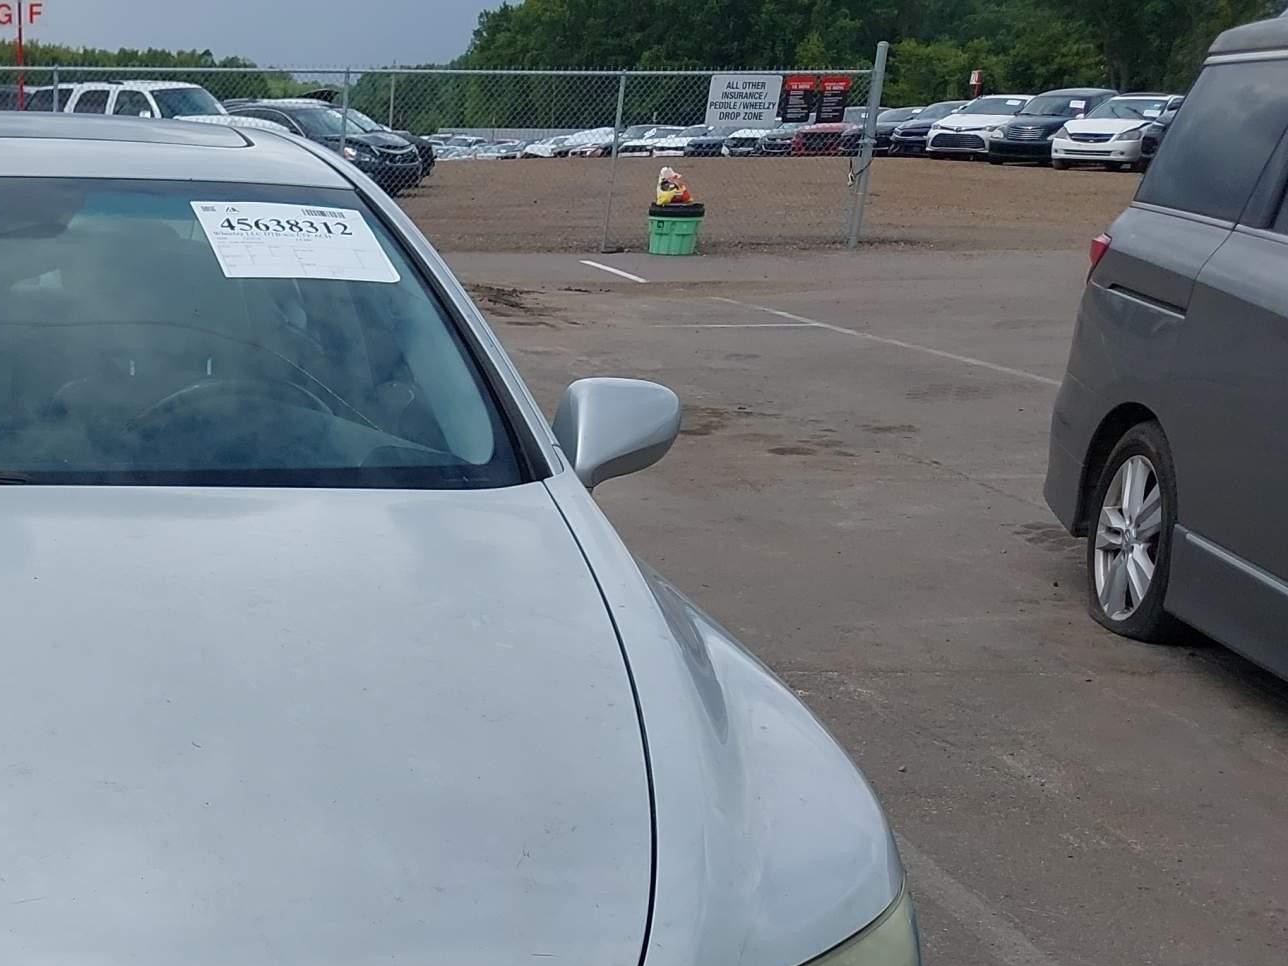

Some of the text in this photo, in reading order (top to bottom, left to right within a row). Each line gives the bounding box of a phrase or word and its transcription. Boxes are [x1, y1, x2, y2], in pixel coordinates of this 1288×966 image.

[29, 3, 42, 24] F
[726, 81, 766, 90] ALL OTHER
[718, 111, 764, 121] DROP ZONE
[220, 216, 353, 236] 45638312
